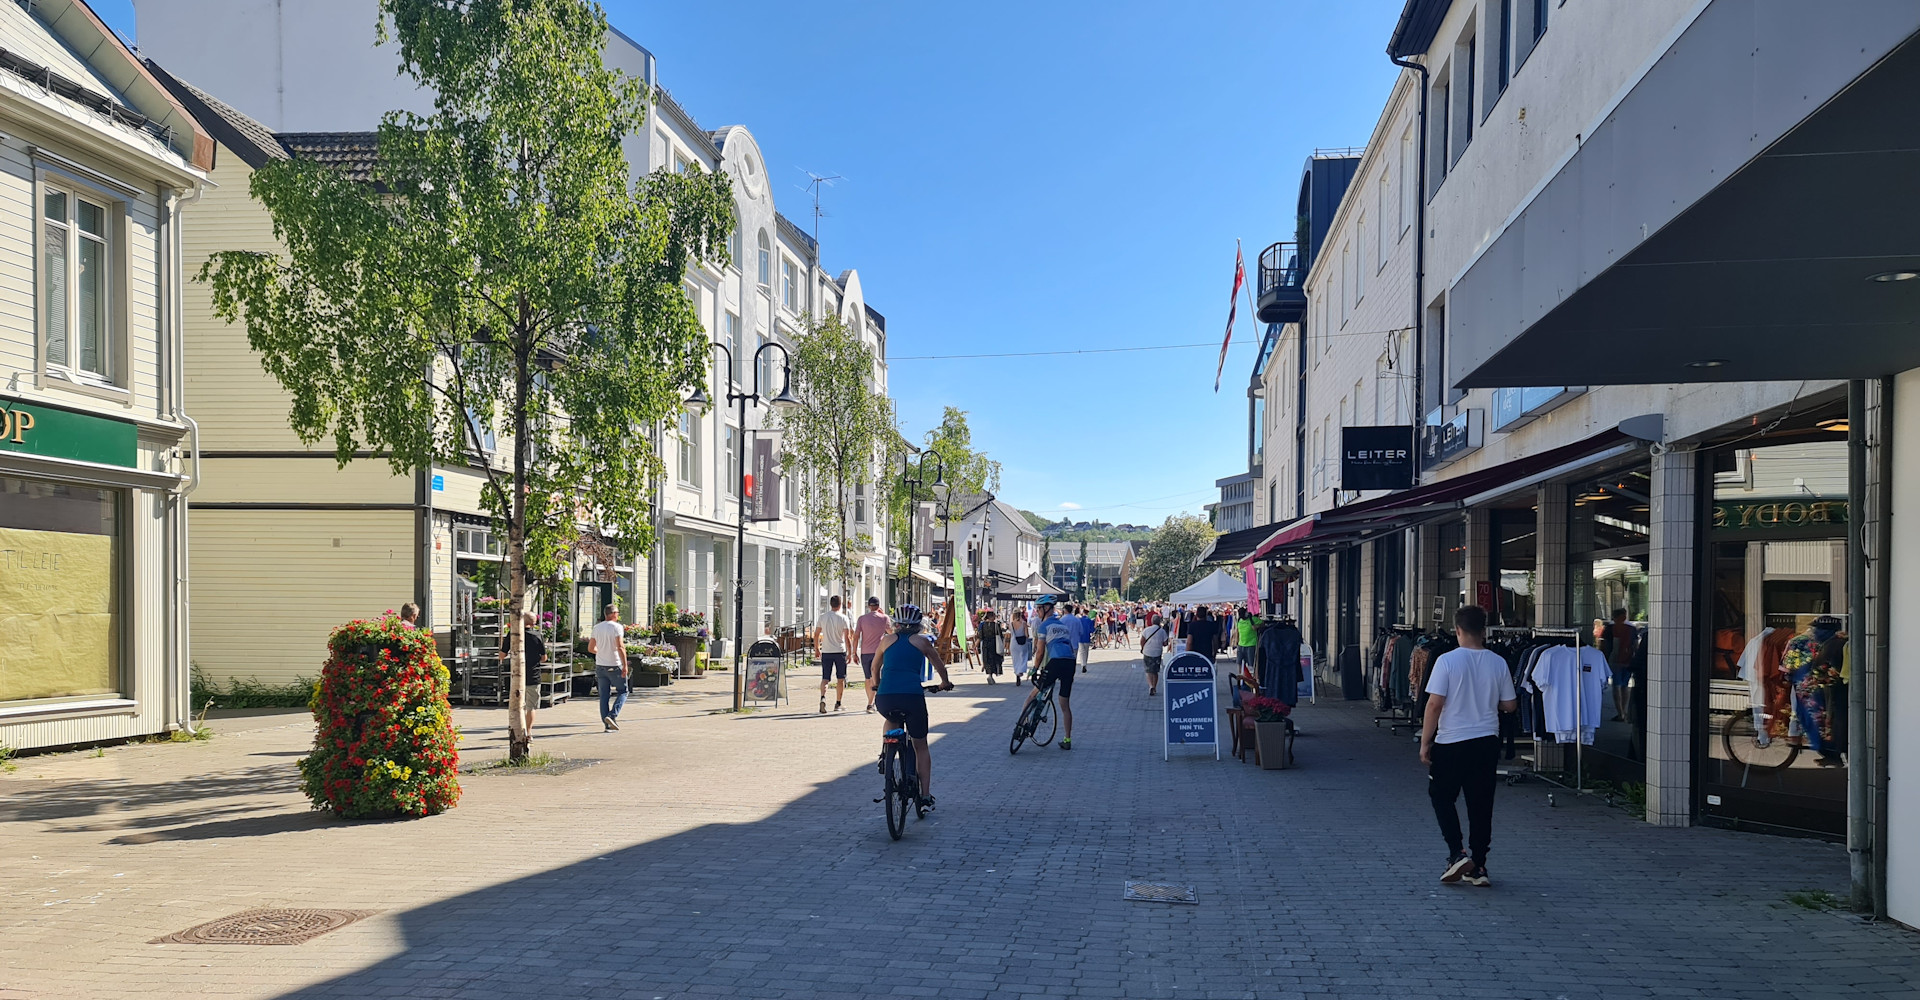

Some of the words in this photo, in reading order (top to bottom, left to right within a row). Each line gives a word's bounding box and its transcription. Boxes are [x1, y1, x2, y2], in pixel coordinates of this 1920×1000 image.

[1347, 449, 1407, 459] LEITER
[0, 549, 28, 570] TIL
[33, 551, 62, 571] LEIE
[1478, 583, 1489, 594] 70
[1171, 687, 1210, 711] ÅPENT
